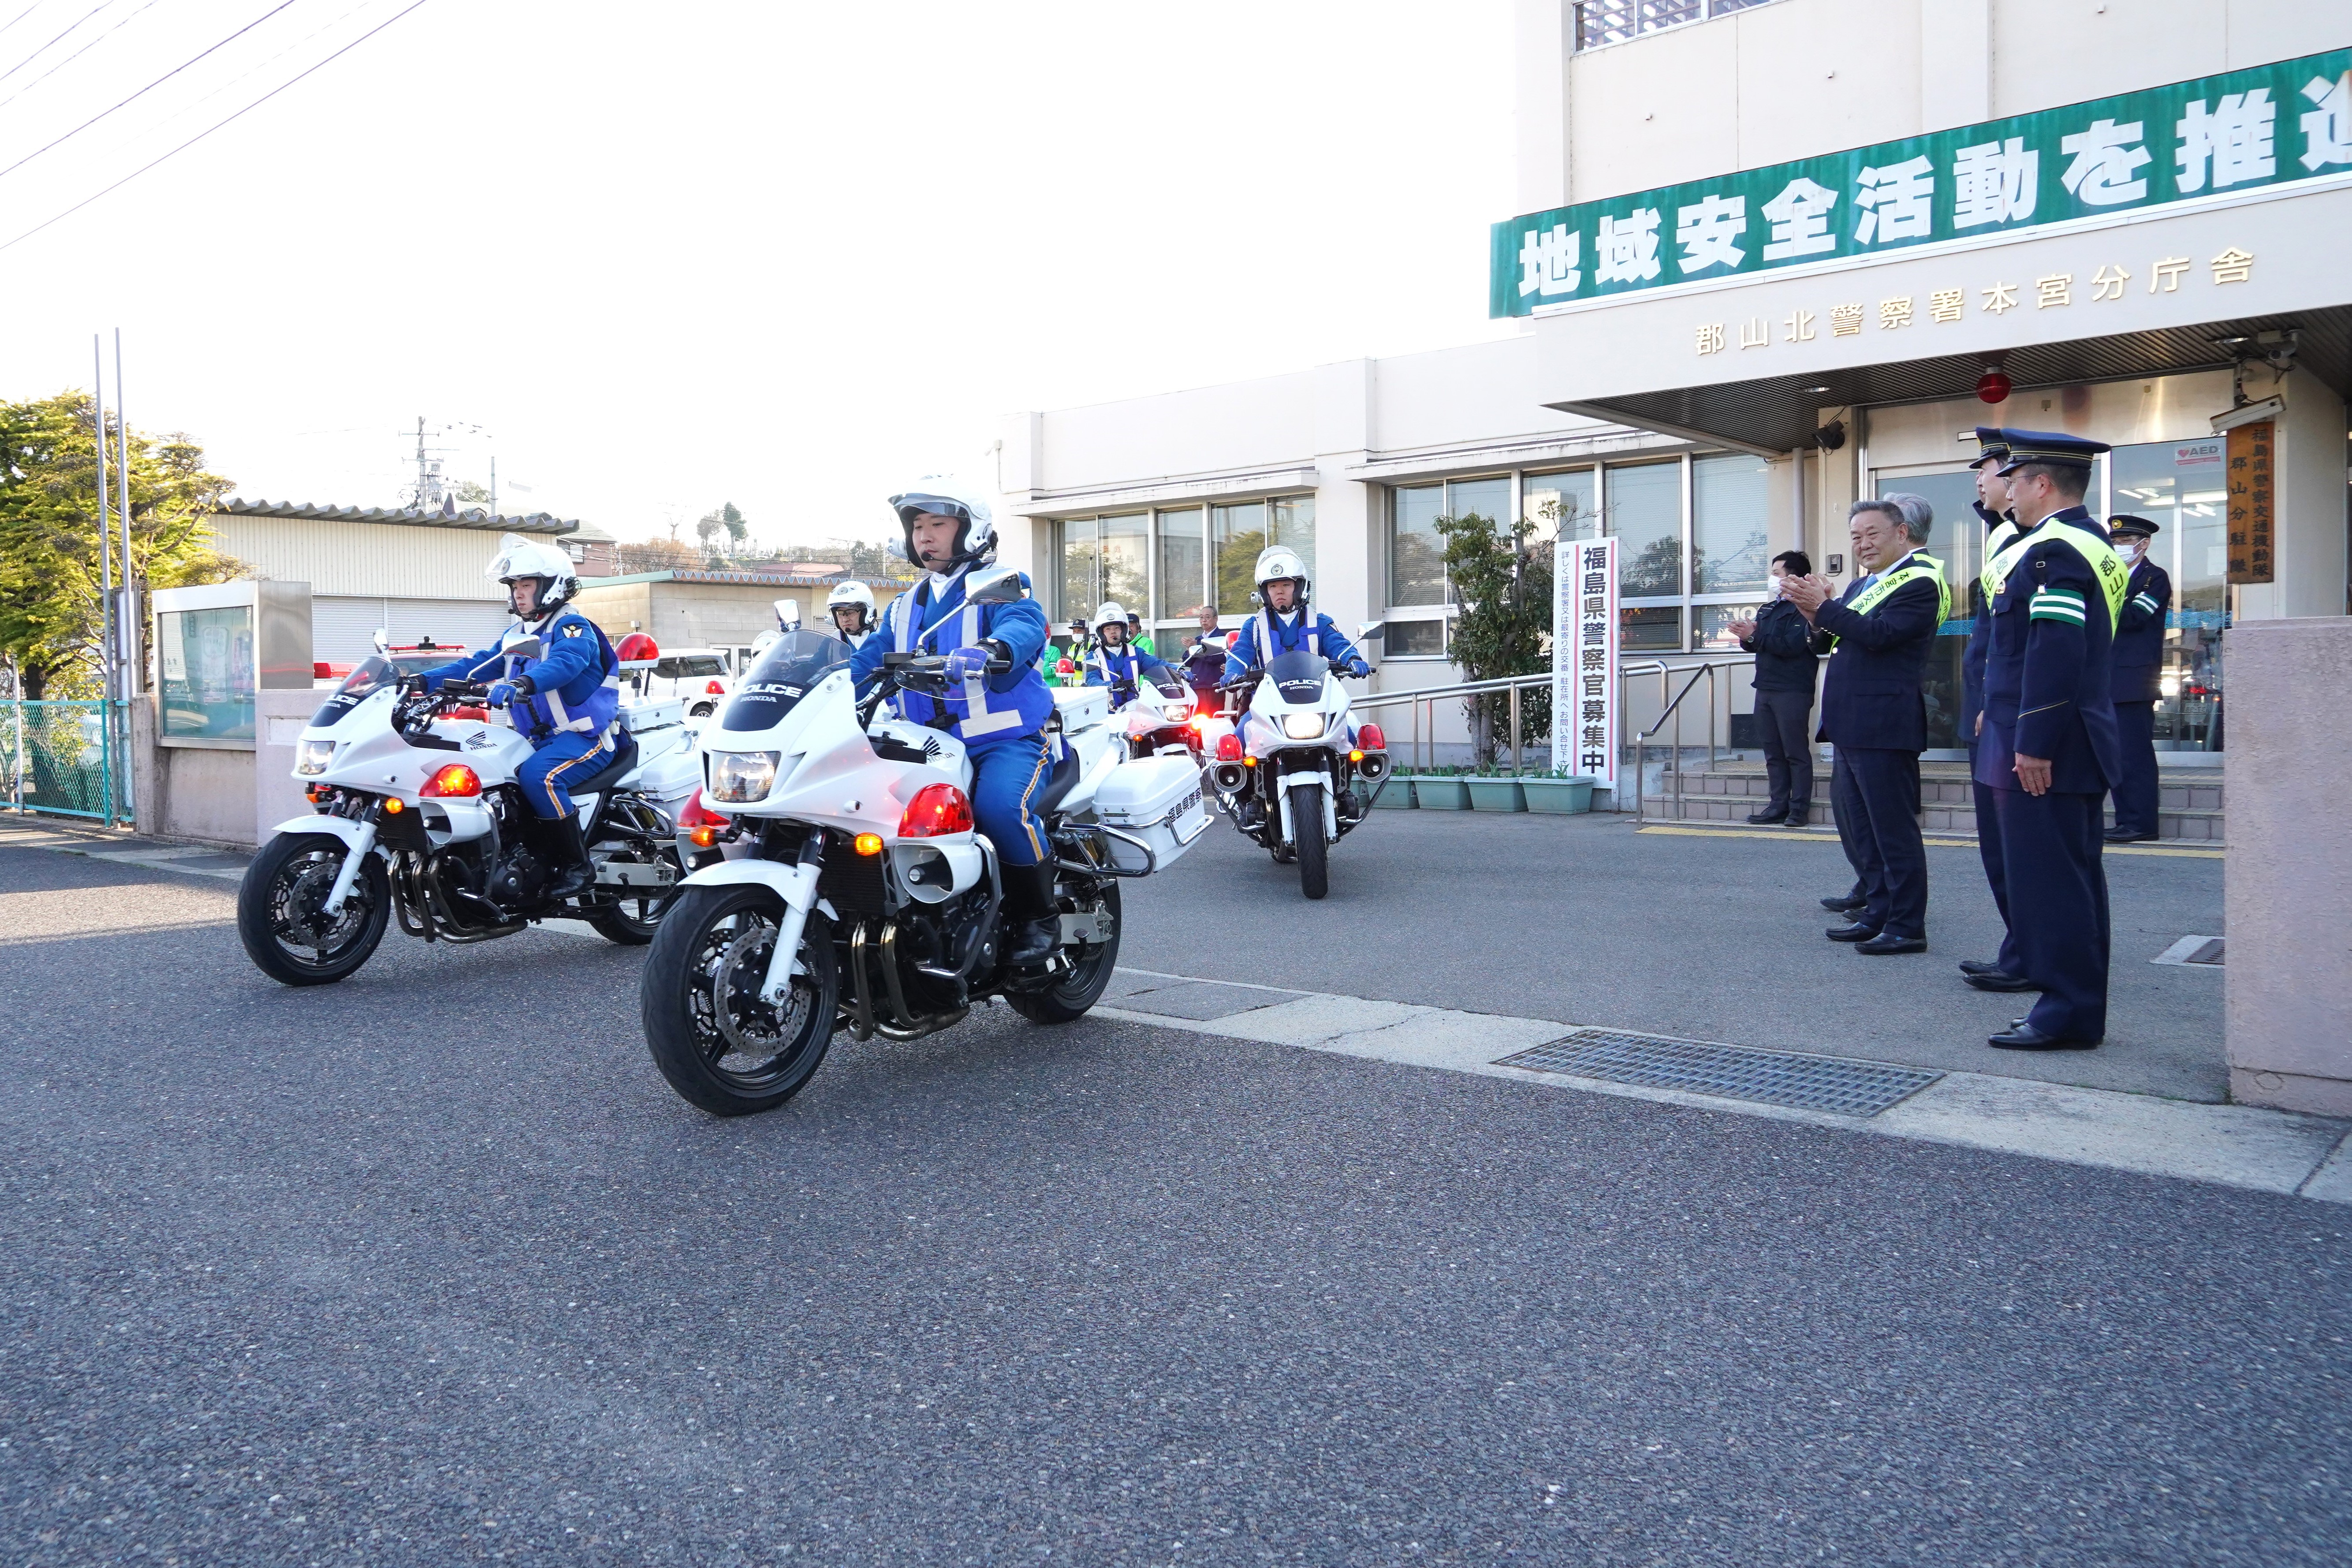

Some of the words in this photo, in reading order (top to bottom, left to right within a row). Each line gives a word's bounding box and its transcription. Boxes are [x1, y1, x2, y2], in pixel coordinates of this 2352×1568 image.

[1696, 247, 2254, 355] 郡山北警察署本宮分庁舎
[2188, 445, 2218, 456] AED
[2252, 428, 2270, 576] 福島県警察交通機動隊
[1279, 679, 1322, 688] POLICE
[1582, 546, 1607, 774] 福島県警察官募集中
[1168, 787, 1201, 822] 福島県警察
